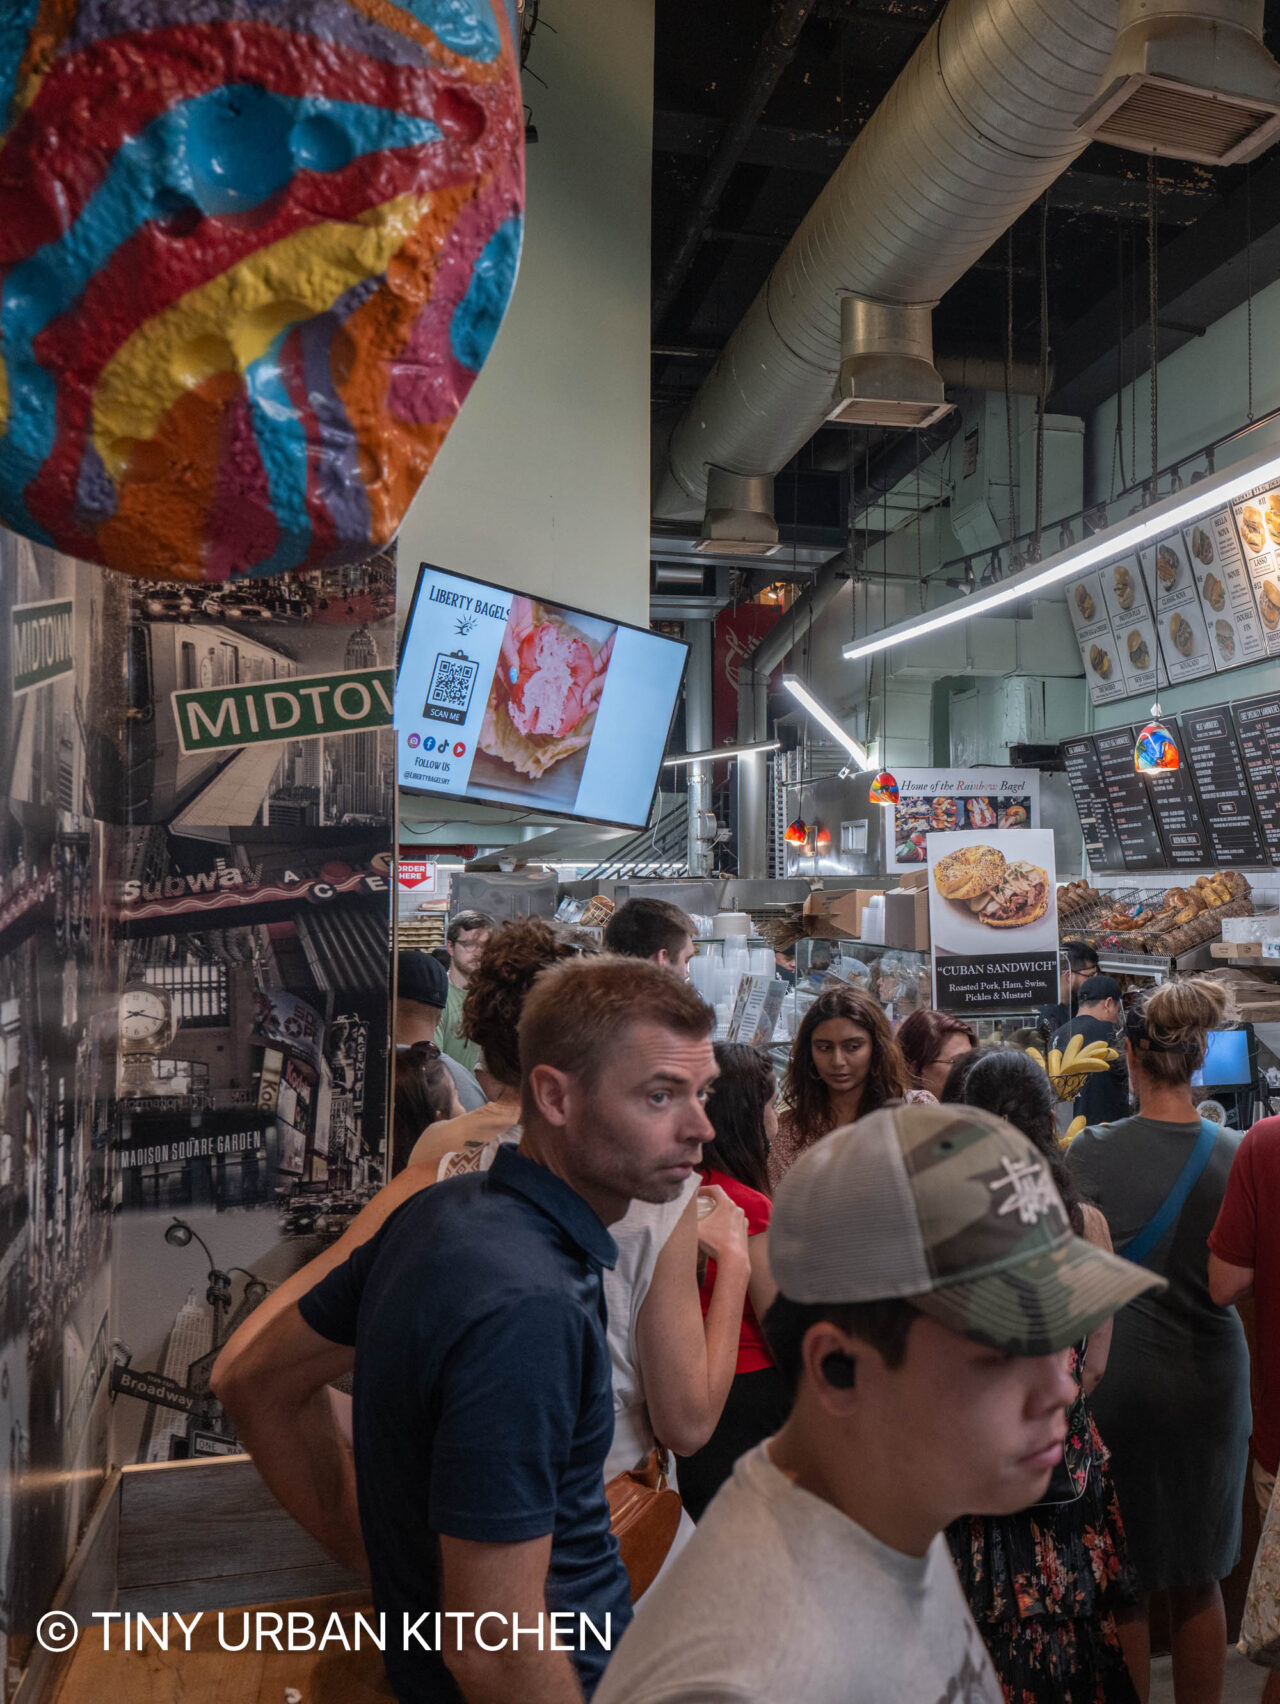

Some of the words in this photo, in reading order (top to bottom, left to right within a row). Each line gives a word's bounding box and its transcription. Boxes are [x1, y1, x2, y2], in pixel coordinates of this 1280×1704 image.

[1253, 556, 1268, 569] LASSO
[429, 585, 473, 613] LIBERTY
[186, 681, 392, 740] MIDTO
[430, 707, 448, 719] SCAN
[449, 711, 460, 722] ME
[414, 756, 441, 771] FOLLOW
[441, 760, 450, 772] US
[901, 780, 928, 791] Home
[930, 780, 941, 792] of
[940, 780, 954, 791] the
[956, 779, 998, 791] Rainbow
[1000, 780, 1026, 793] Bagel
[948, 982, 979, 992] Roasted
[980, 981, 1001, 990] Pork,
[1002, 980, 1023, 989] Ham,
[1024, 979, 1048, 988] Swiss,
[965, 991, 992, 1002] Pickles
[993, 991, 1000, 1000] &
[1001, 990, 1032, 1000] Mustard
[121, 1144, 169, 1169] MADISON
[171, 1136, 214, 1161] SQUARE
[217, 1130, 261, 1154] GARDEN
[120, 1373, 193, 1409] Broadway
[199, 1439, 217, 1452] ONE
